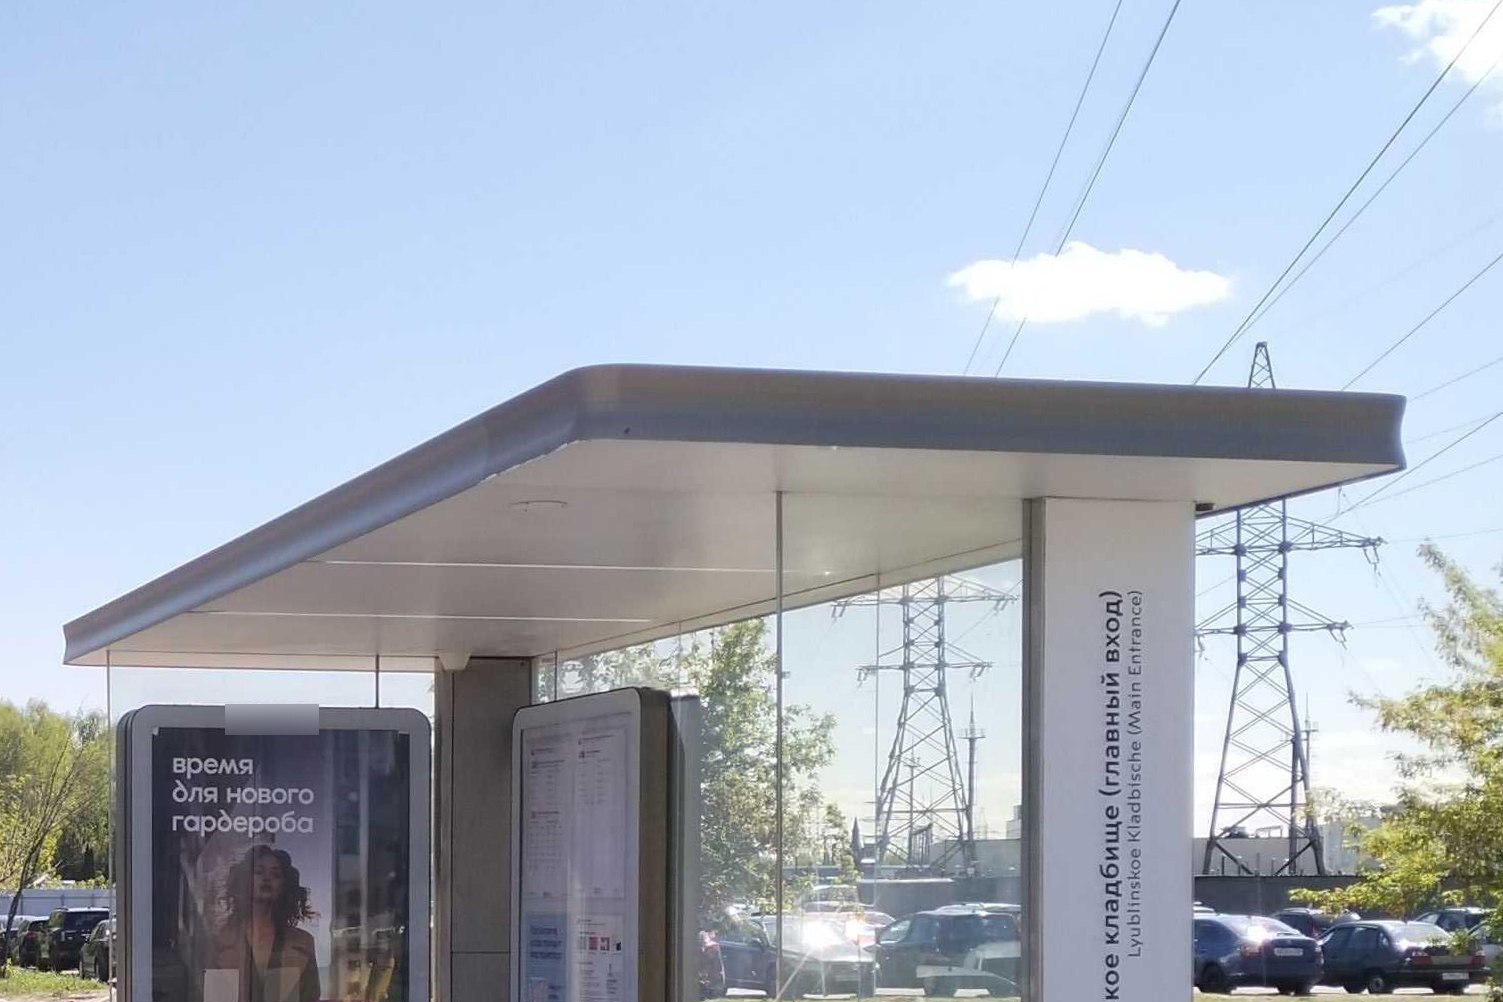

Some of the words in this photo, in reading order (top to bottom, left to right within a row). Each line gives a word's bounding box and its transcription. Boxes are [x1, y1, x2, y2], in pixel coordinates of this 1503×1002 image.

[1099, 590, 1123, 663] вход)
[1127, 590, 1143, 675] Entrance)
[1099, 672, 1122, 797] (главный
[1127, 682, 1143, 735] (Main
[172, 757, 254, 779] время
[172, 779, 218, 803] для
[226, 787, 315, 804] нового
[1127, 740, 1142, 843] Kladbische
[172, 809, 314, 838] гардероба
[1099, 805, 1123, 945] кладбище
[1127, 848, 1143, 958] Lyublinskoe
